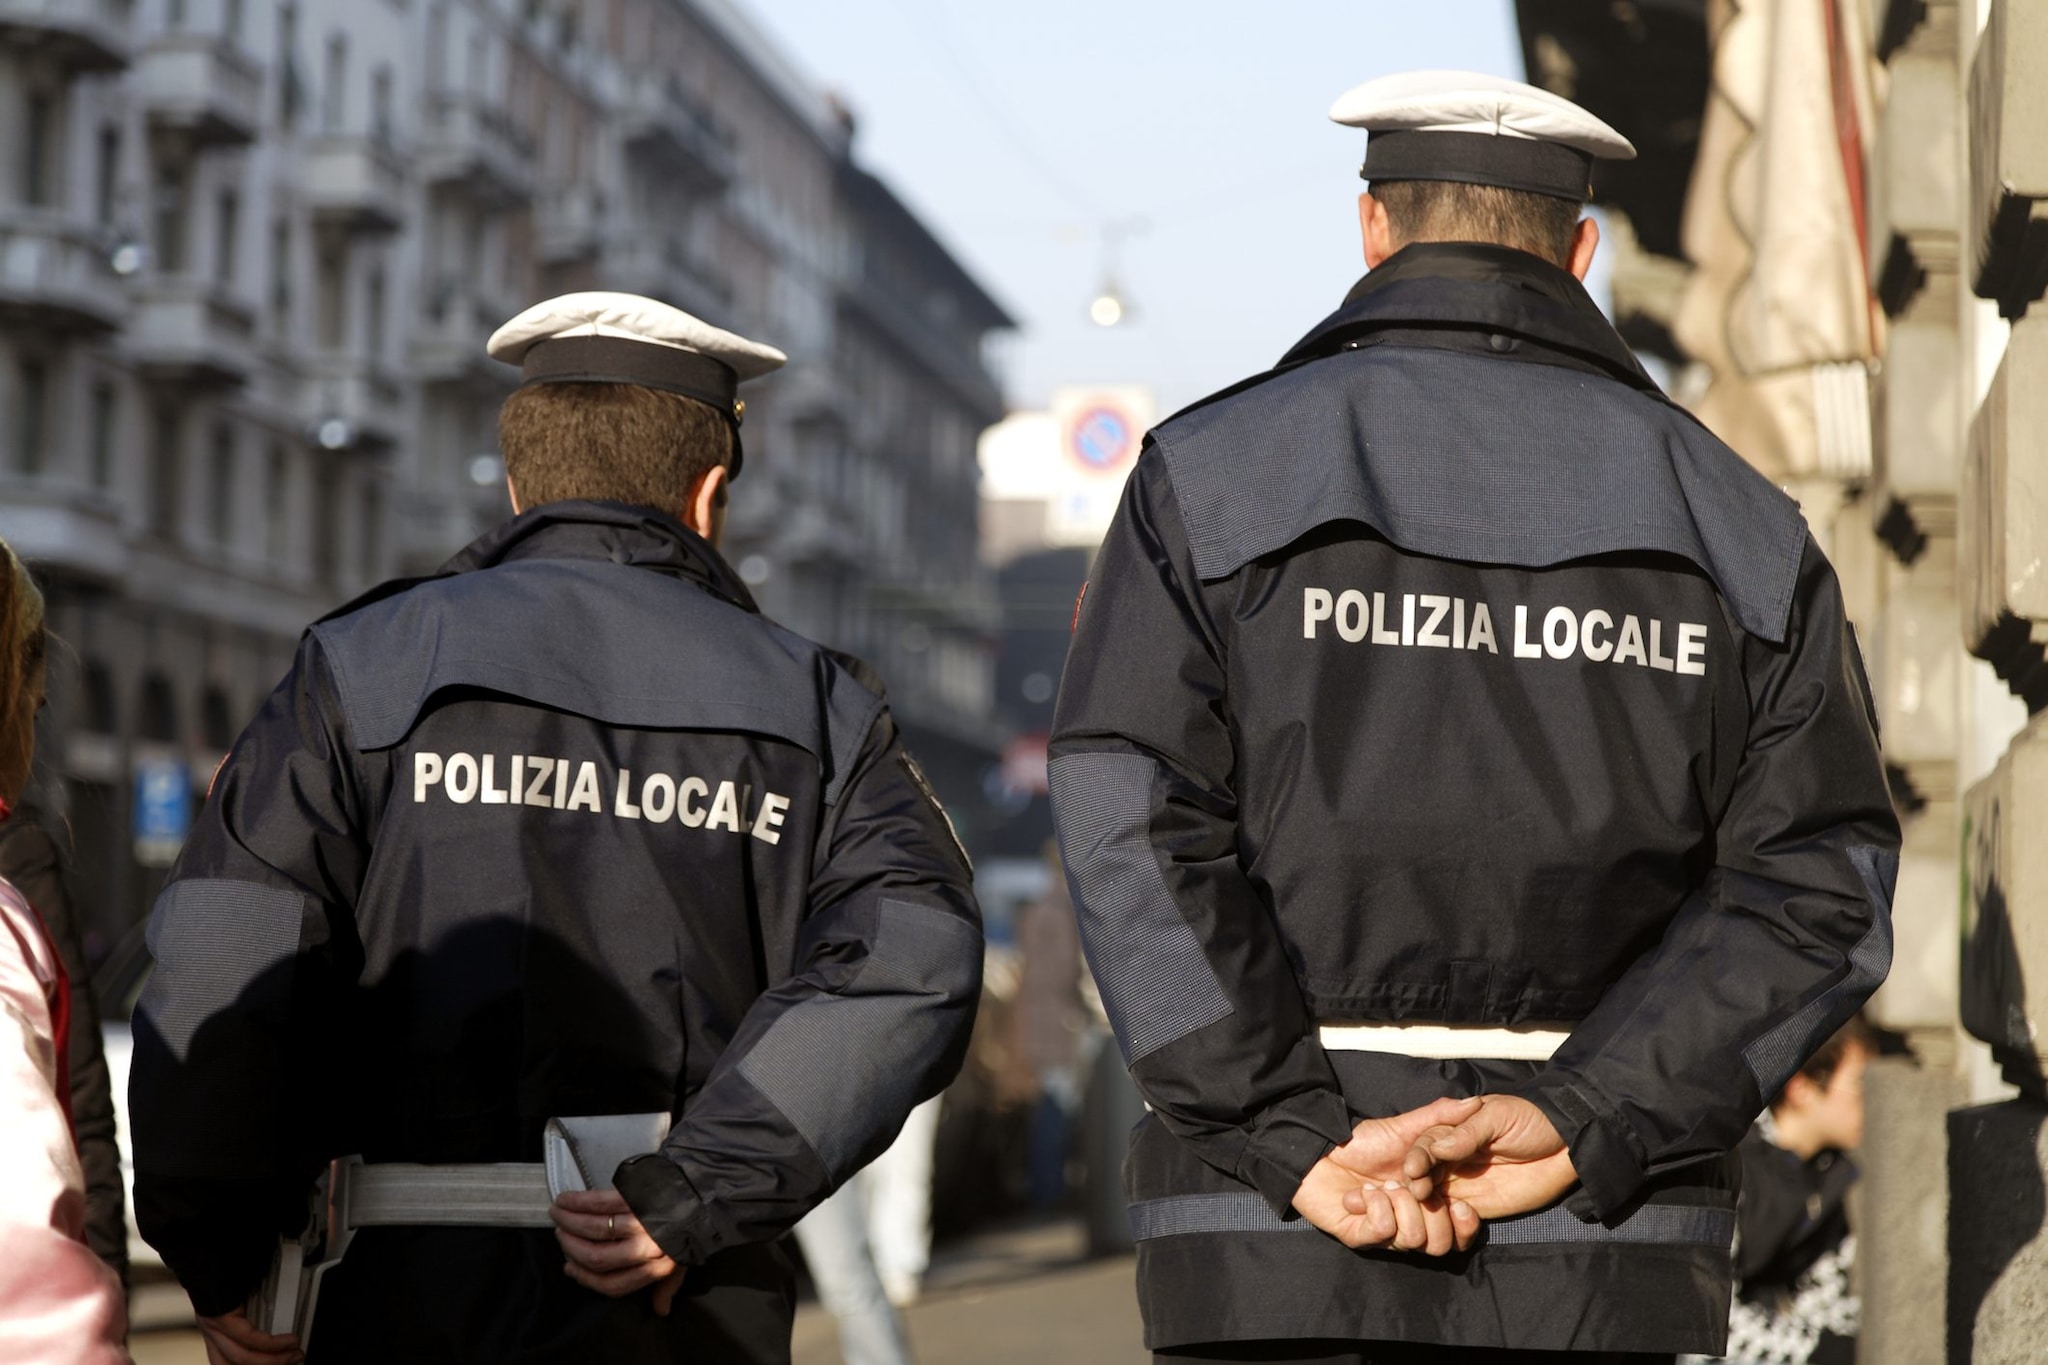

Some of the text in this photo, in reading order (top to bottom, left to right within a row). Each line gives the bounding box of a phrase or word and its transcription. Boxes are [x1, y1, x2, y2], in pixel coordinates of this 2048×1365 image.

[1303, 587, 1708, 676] POLIZIA LOCALE
[413, 751, 791, 845] POLIZIA LOCALE
